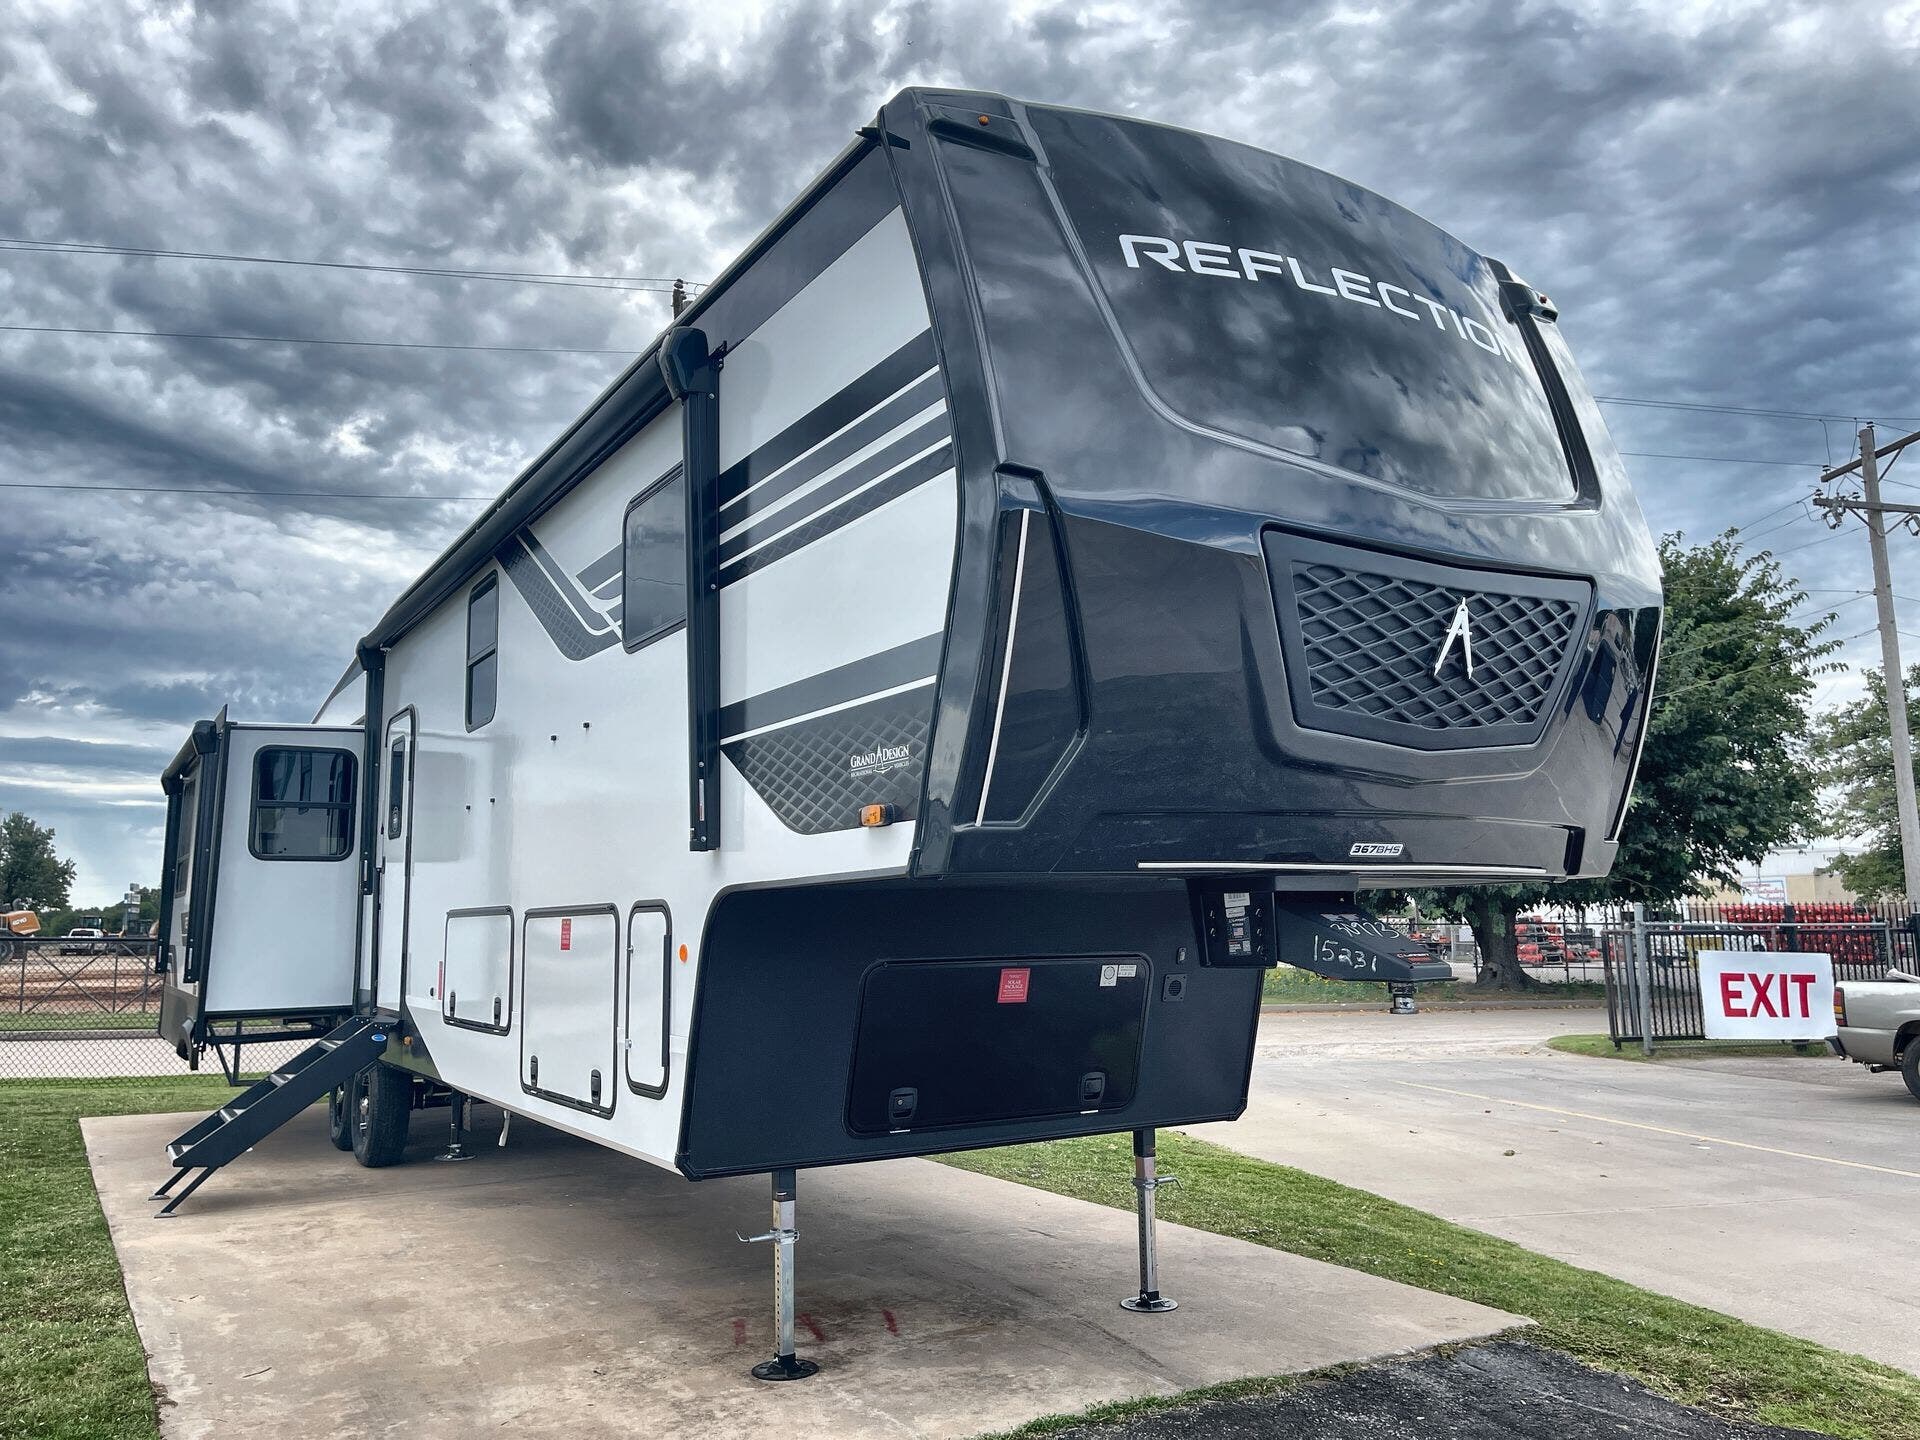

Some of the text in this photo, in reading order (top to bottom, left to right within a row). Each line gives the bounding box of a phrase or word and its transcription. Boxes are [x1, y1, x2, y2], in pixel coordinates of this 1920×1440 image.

[850, 752, 876, 768] GRAND
[882, 744, 909, 761] DESIGN
[1352, 845, 1400, 854] 367BHS
[1313, 934, 1377, 973] 15231
[1719, 972, 1816, 1018] EXIT
